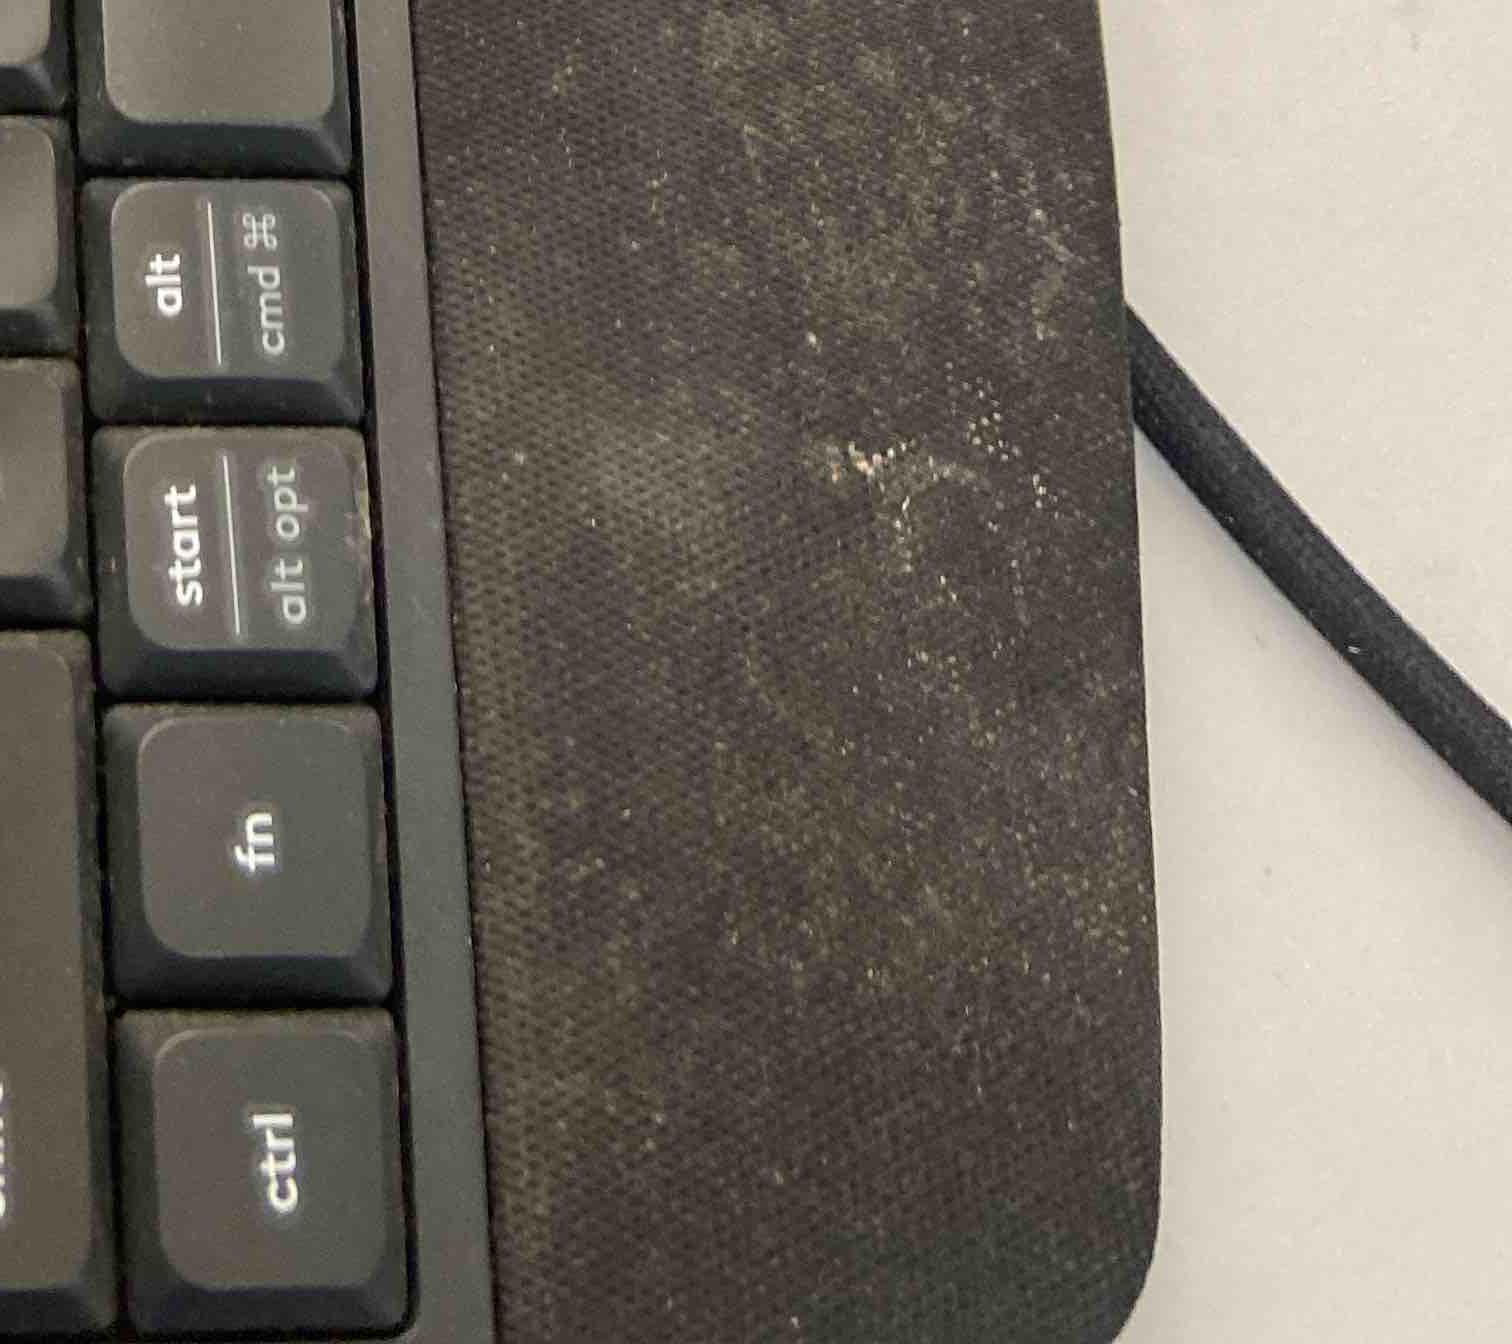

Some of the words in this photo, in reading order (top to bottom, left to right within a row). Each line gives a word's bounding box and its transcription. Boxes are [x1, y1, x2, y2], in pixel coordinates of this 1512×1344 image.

[144, 253, 183, 317] alt
[247, 265, 285, 355] cmd
[267, 466, 309, 542] opt
[164, 484, 203, 606] start
[270, 558, 307, 625] alt
[234, 812, 275, 873] fn
[251, 1113, 298, 1214] ctrl
